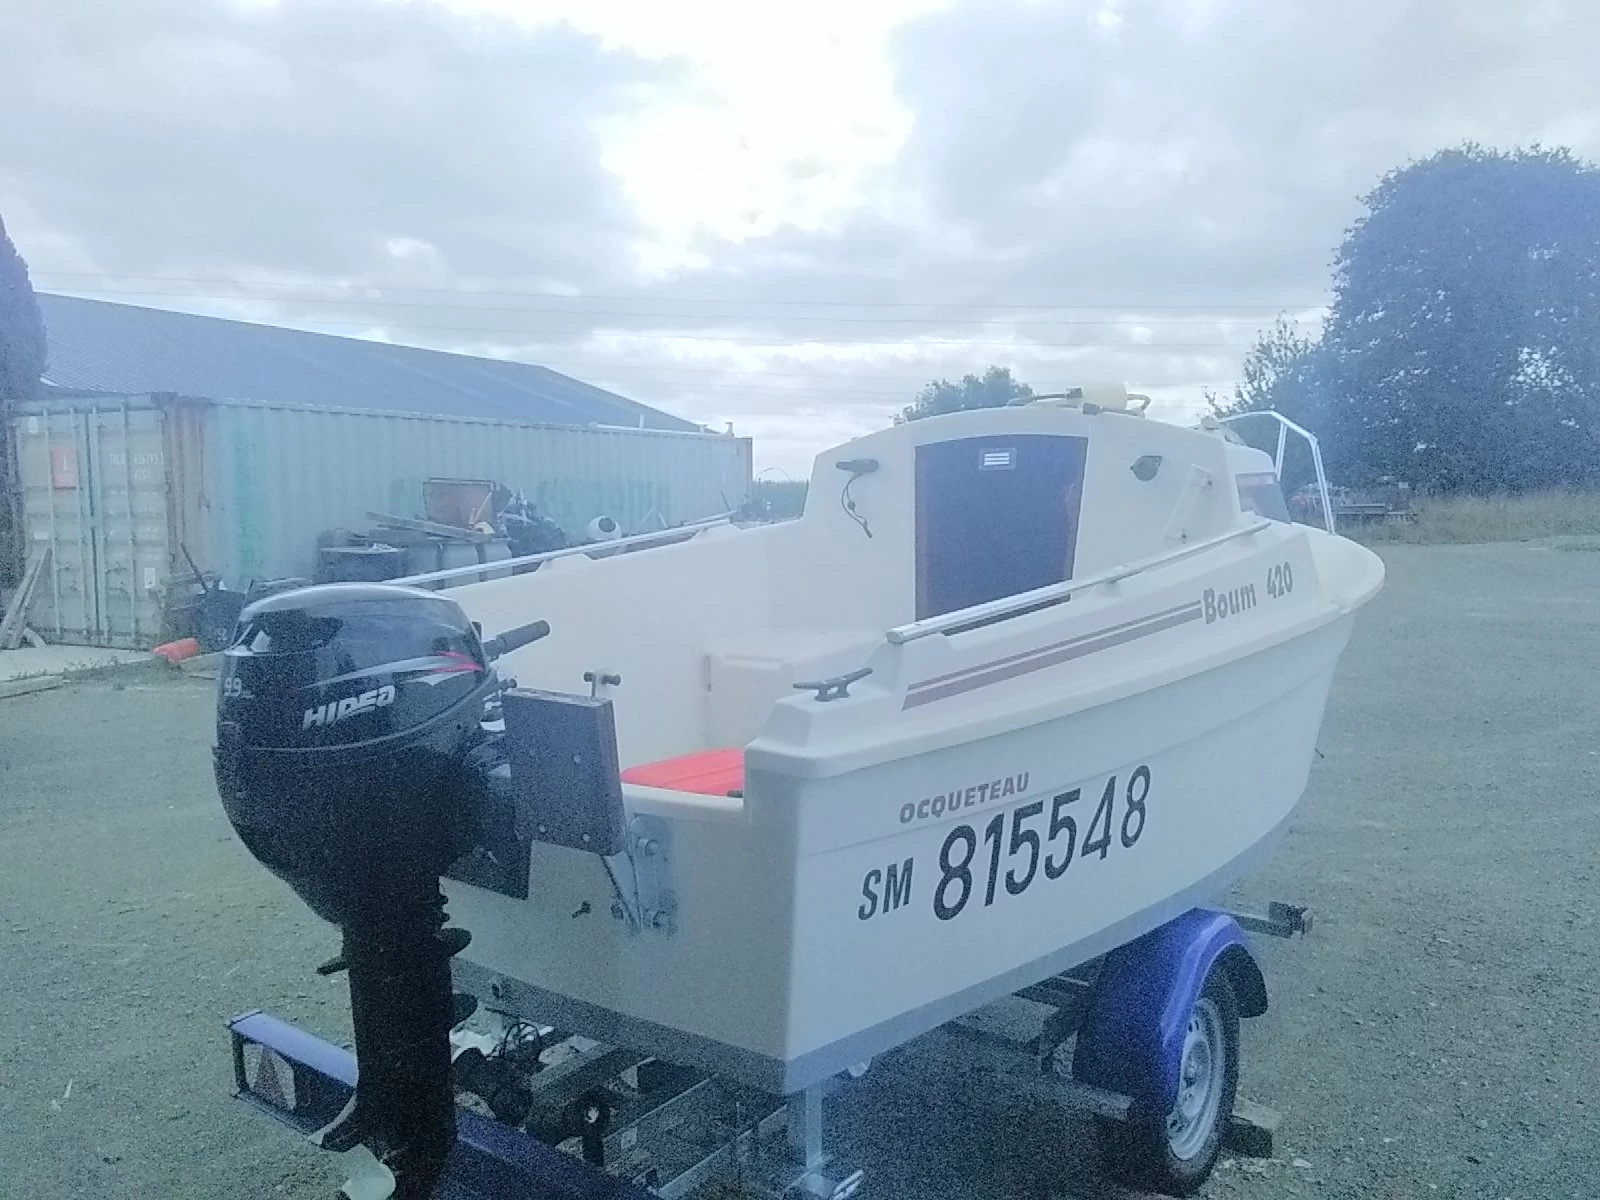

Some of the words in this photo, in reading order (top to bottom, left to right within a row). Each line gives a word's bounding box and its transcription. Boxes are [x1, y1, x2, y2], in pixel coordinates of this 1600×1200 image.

[1203, 583, 1257, 624] Boum
[1267, 561, 1293, 598] 420
[302, 685, 396, 731] HIDEA
[899, 772, 1029, 824] OCQUETEAU
[857, 857, 914, 921] SM
[932, 764, 1151, 921] 815548
